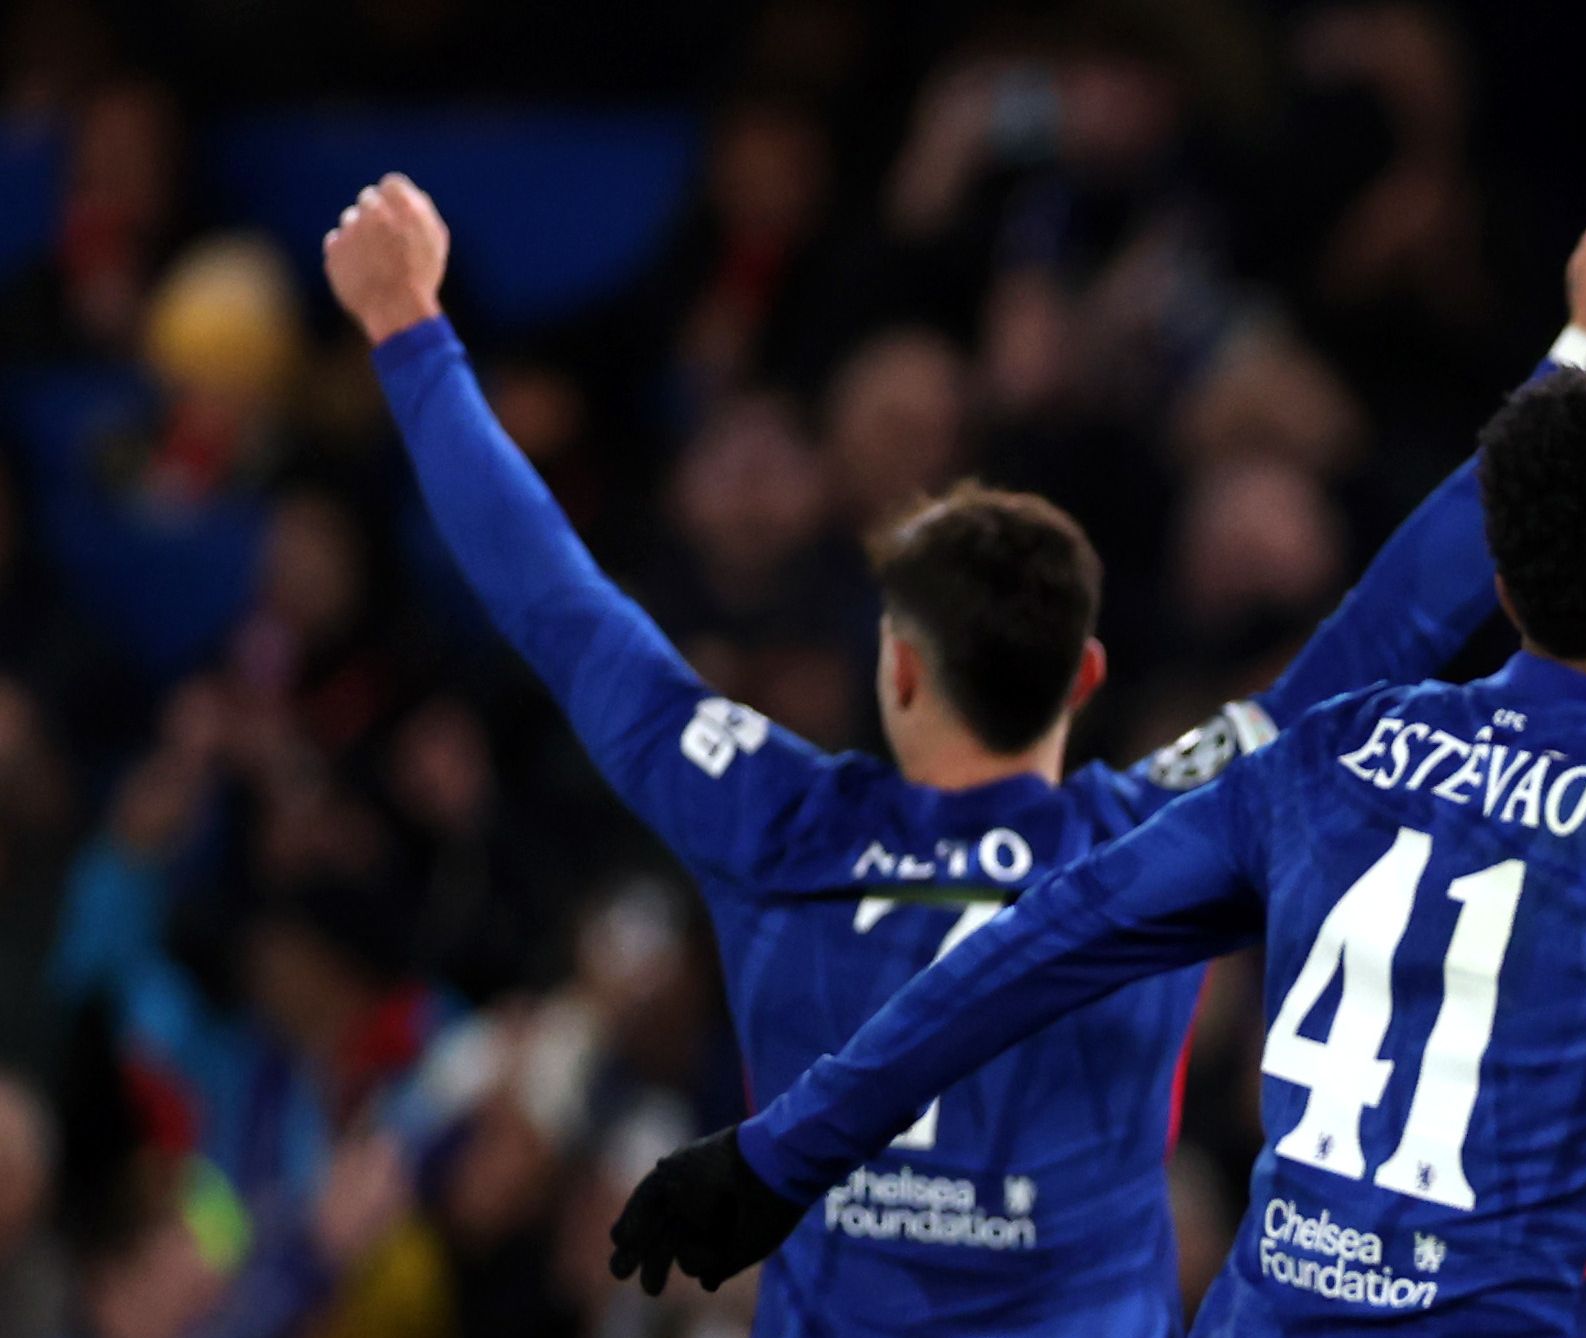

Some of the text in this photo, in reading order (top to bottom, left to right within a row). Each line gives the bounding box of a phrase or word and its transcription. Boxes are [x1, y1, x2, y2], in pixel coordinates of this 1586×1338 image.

[1261, 825, 1526, 1212] 41
[1264, 1198, 1383, 1265] Chelsea
[1259, 1236, 1439, 1309] Foundation
